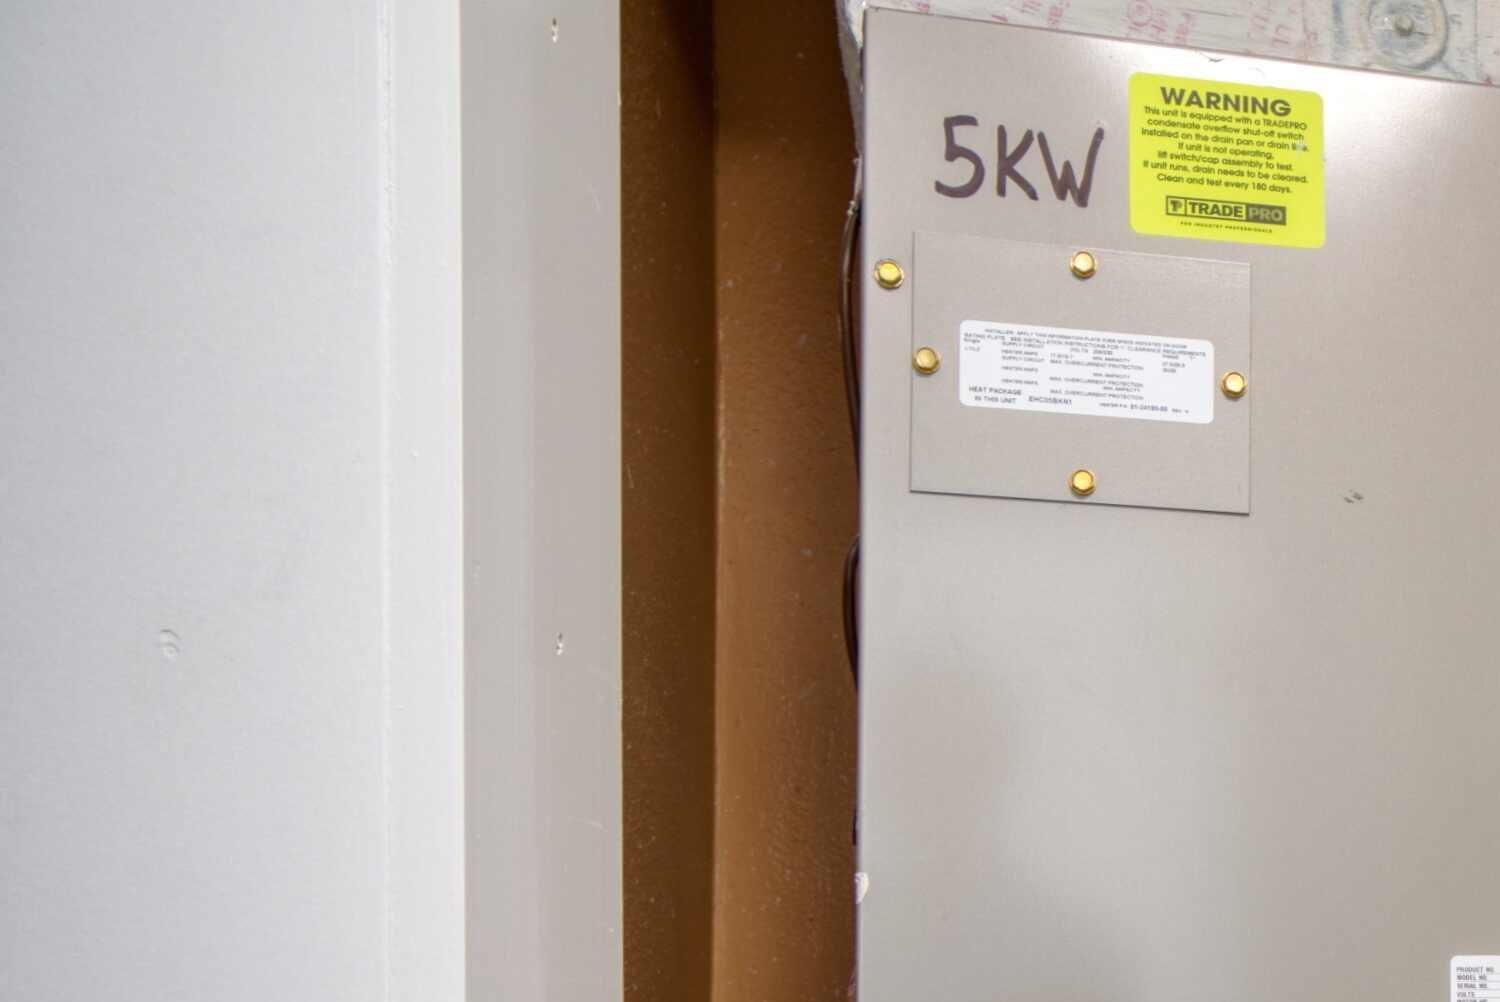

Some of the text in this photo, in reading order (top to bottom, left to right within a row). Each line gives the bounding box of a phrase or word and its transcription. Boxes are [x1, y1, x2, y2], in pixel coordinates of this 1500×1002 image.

[1160, 86, 1291, 117] WARNING
[1144, 106, 1159, 115] This
[1162, 108, 1178, 116] unit
[1181, 110, 1187, 118] is
[1189, 111, 1232, 123] equipped
[1235, 116, 1252, 124] with
[1263, 119, 1307, 130] TRADEPRO
[1147, 117, 1200, 130] condensate
[1203, 123, 1240, 134] overflow
[1277, 131, 1303, 140] switch
[1185, 143, 1202, 151] unit
[1214, 146, 1227, 154] not
[1195, 133, 1208, 141] the
[1211, 135, 1233, 144] drain
[1236, 138, 1253, 147] pan
[1267, 140, 1289, 149] drain
[934, 114, 1104, 208] 5KW
[1150, 161, 1167, 169] unit
[1192, 165, 1215, 174] drain
[1217, 167, 1244, 177] needs
[1247, 170, 1255, 178] to
[1257, 171, 1269, 179] be
[1169, 152, 1219, 165] switch/cap
[1221, 157, 1262, 169] assembly
[1156, 172, 1184, 183] Clean
[1186, 176, 1204, 185] and
[1206, 178, 1222, 186] test
[1224, 180, 1248, 190] every
[1189, 201, 1282, 221] TRADE PRO
